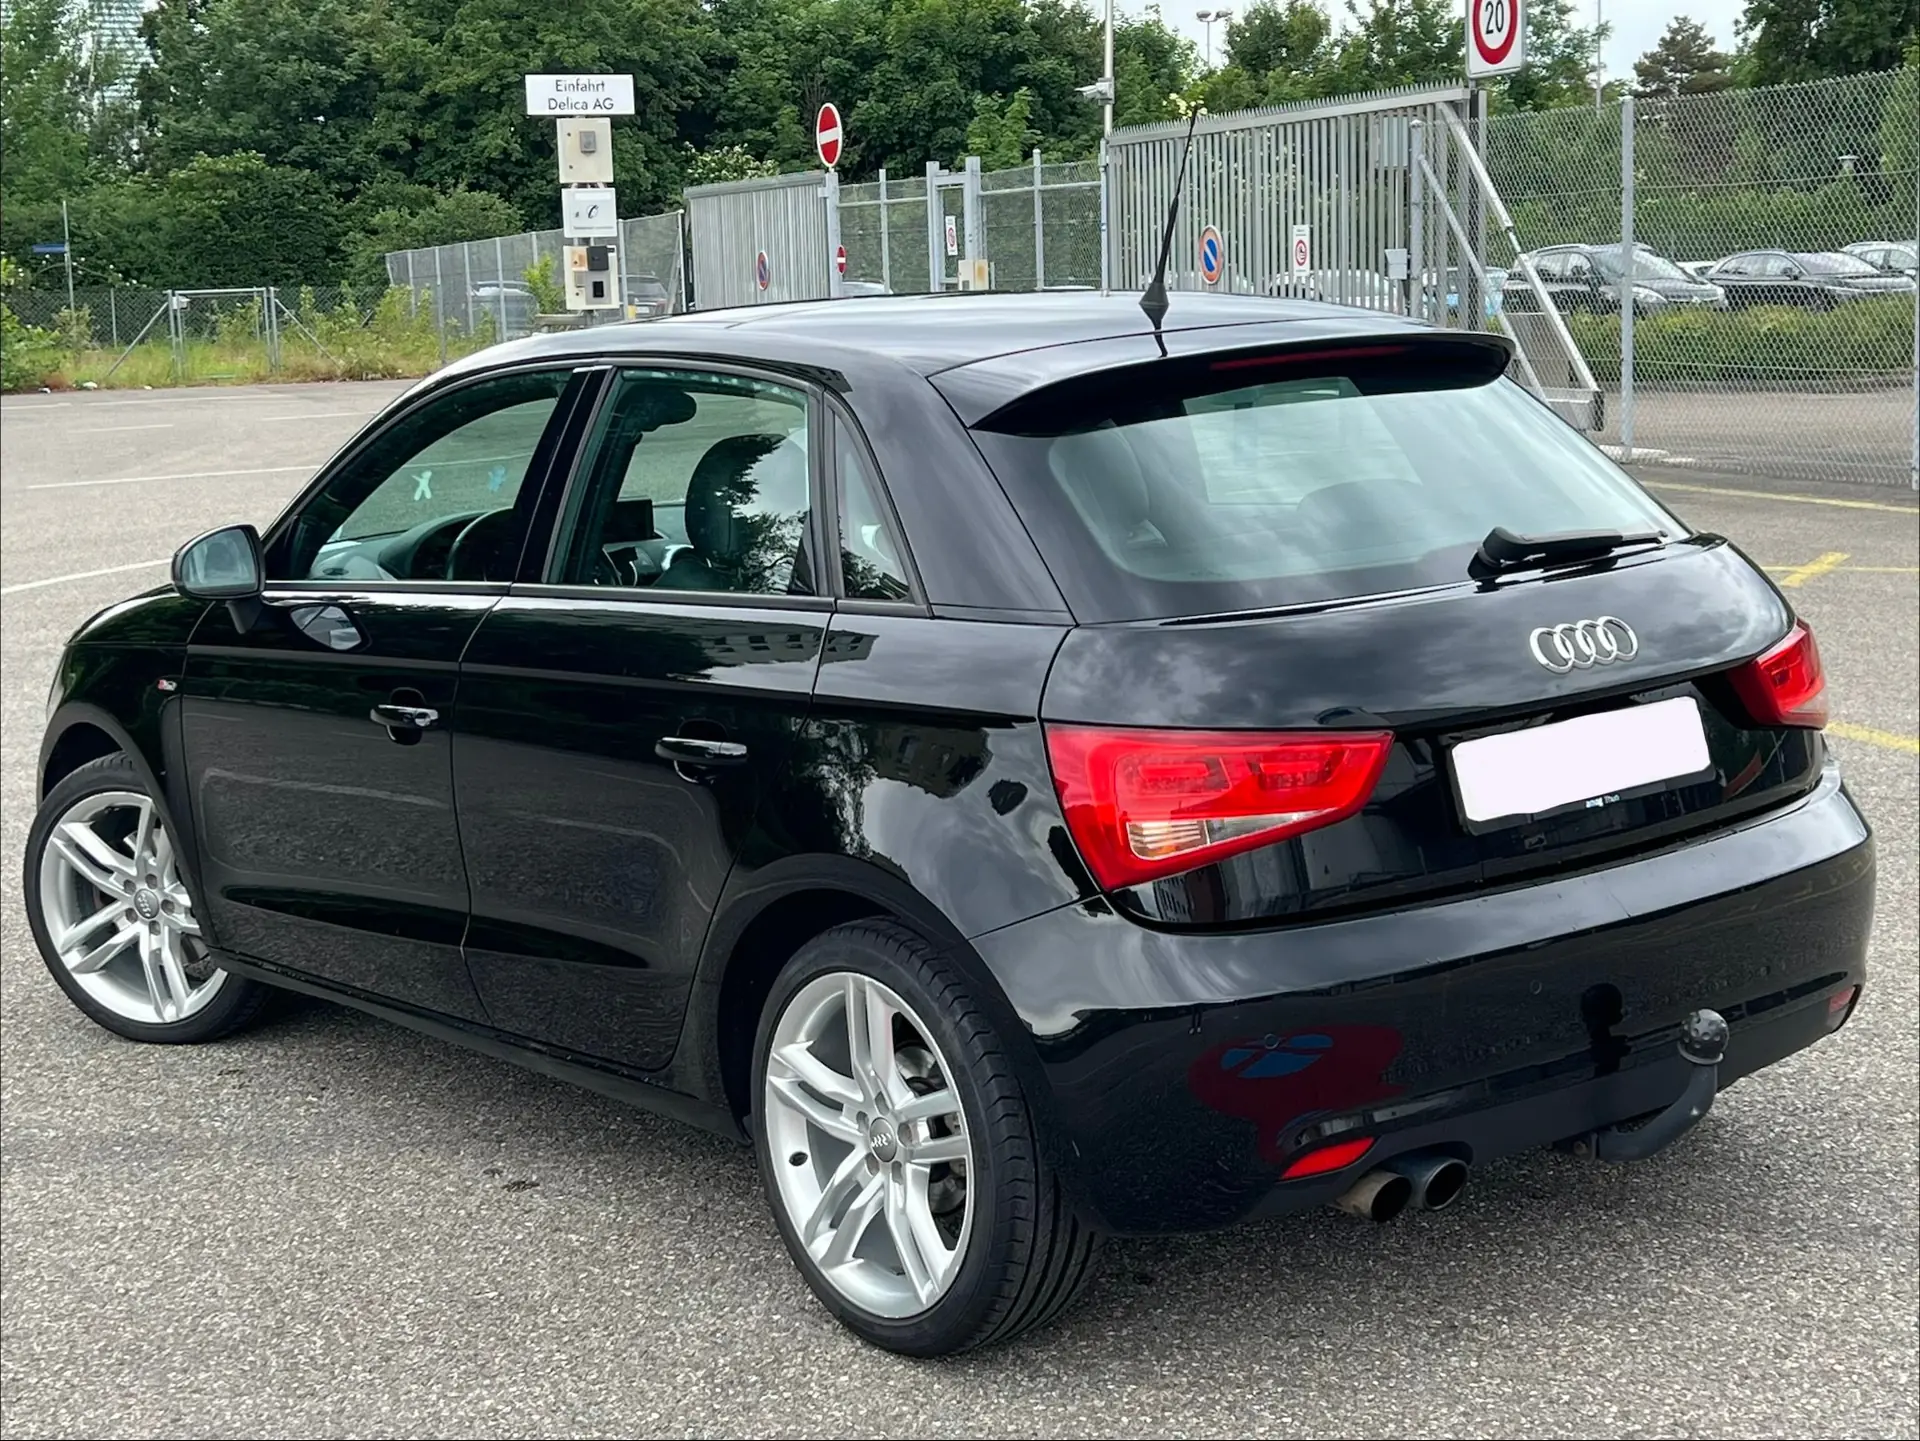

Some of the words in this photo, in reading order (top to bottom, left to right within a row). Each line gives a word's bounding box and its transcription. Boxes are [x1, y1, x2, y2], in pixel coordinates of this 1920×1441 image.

[1485, 0, 1504, 34] 20
[555, 79, 605, 92] Einfahrt
[548, 97, 588, 110] Delica
[593, 98, 614, 110] AG
